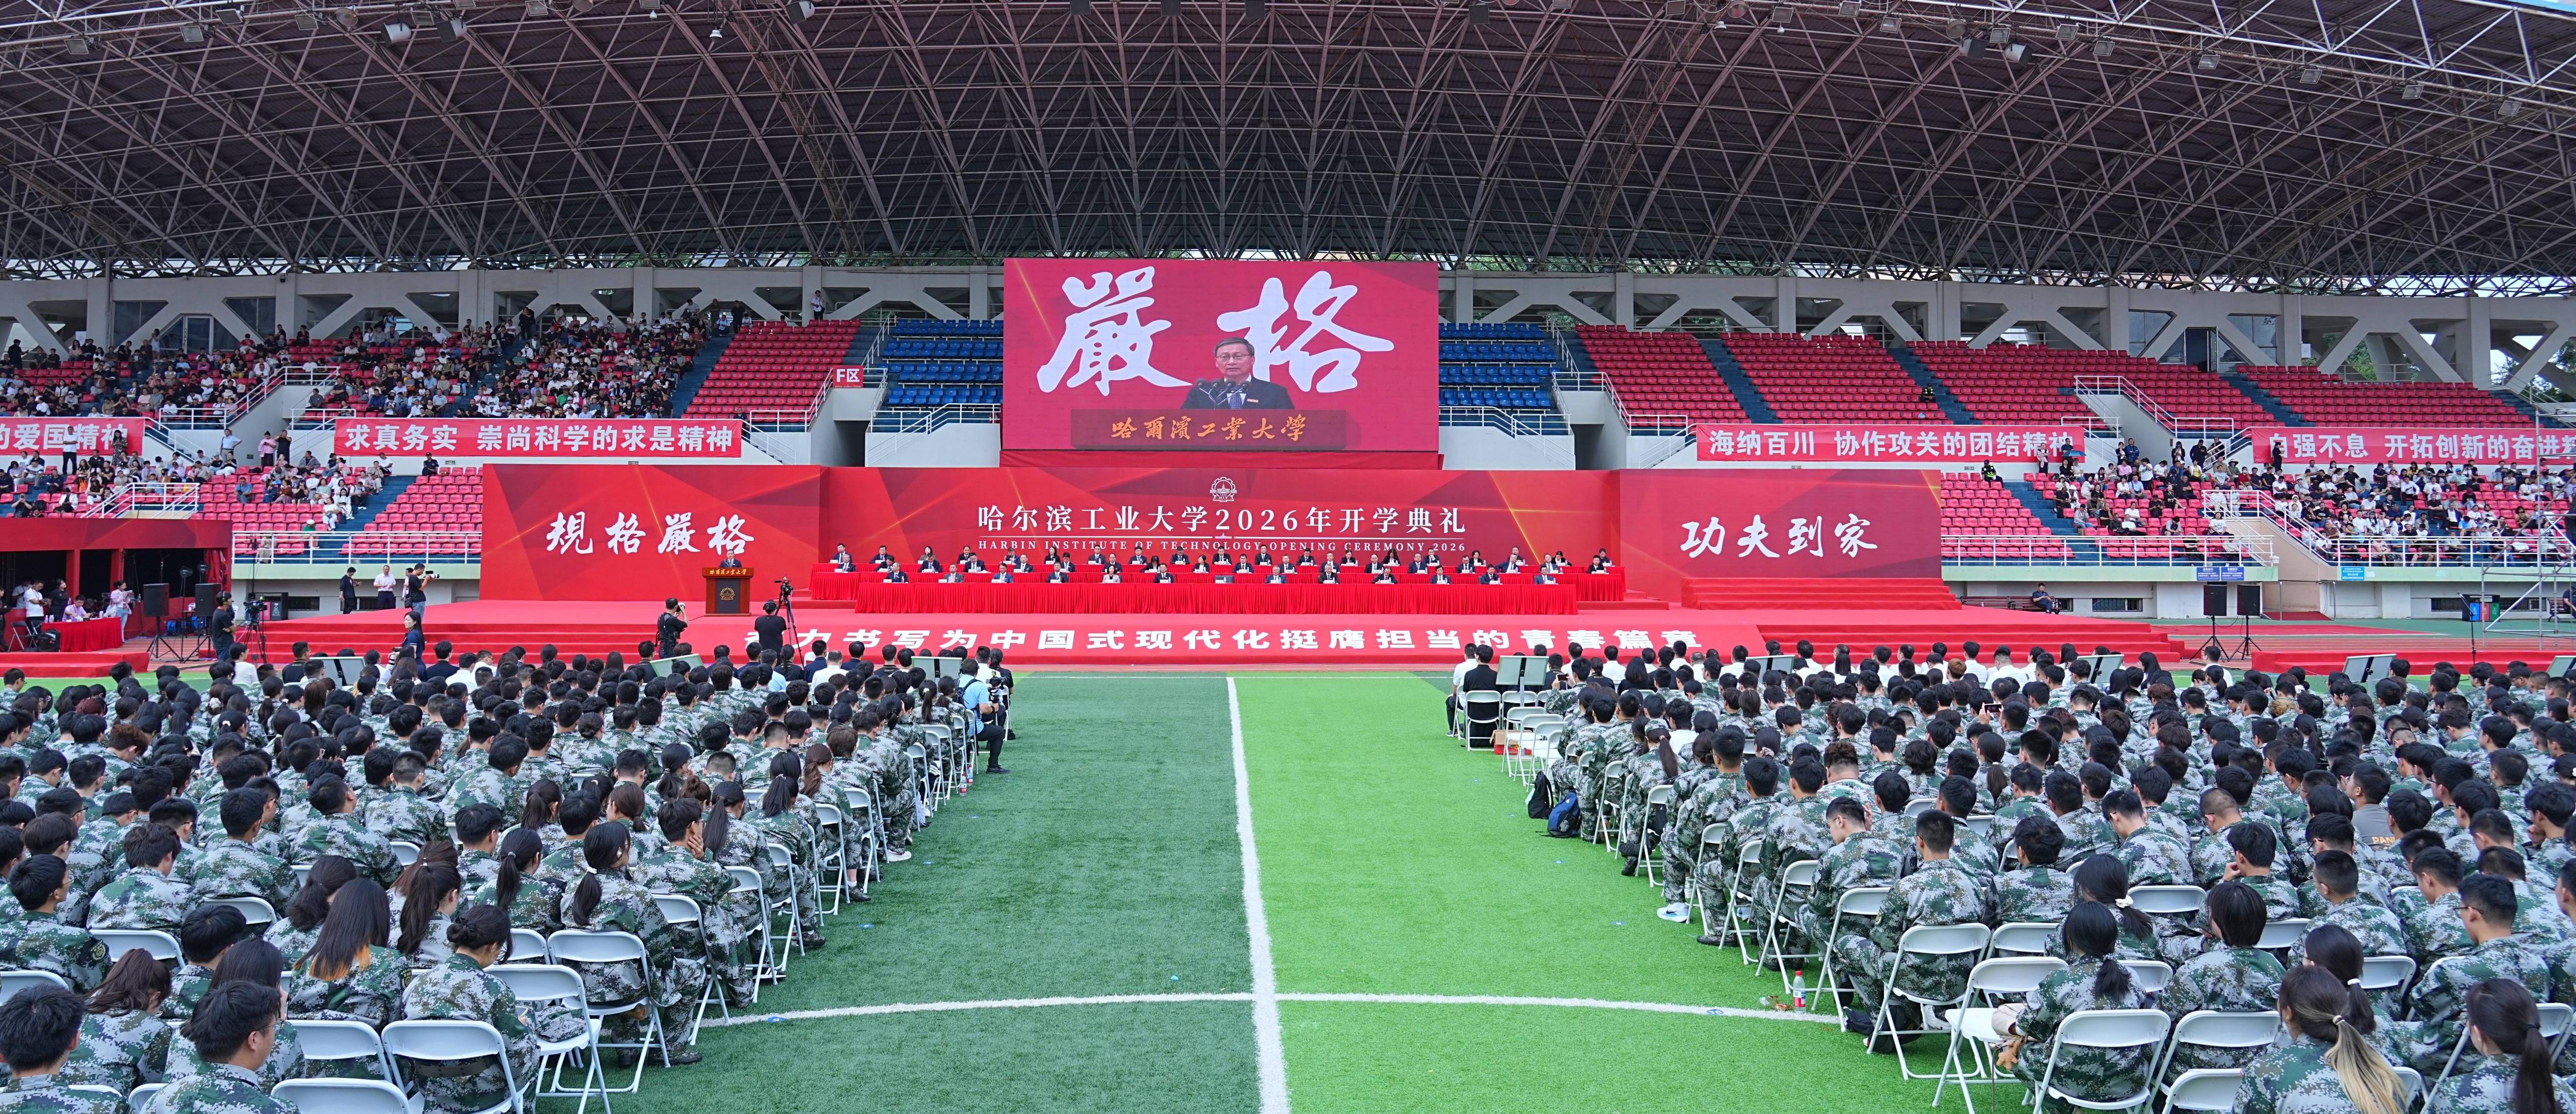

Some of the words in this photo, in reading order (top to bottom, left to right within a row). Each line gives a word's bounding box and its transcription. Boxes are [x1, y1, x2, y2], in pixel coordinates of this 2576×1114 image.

[837, 368, 859, 382] F区
[345, 424, 457, 451] 求真务实
[477, 425, 732, 452] 崇尚科学的求是精神
[1709, 430, 1814, 455] 海纳百川
[1834, 431, 2073, 457] 协作攻关的团结精神
[2270, 433, 2368, 458] 自强不息
[979, 505, 1466, 533] 哈尔滨工业大学2026年开学典礼
[979, 541, 1036, 549] HARBIN
[1045, 541, 1126, 549] INSTITUTE
[1135, 541, 1153, 549] OF
[1161, 541, 1261, 550] TECHNOLOGY
[1270, 542, 1336, 550] OPENING
[1344, 542, 1425, 551] CEREMONY
[1433, 543, 1465, 551] 2026
[1680, 514, 1878, 558] 功夫到家
